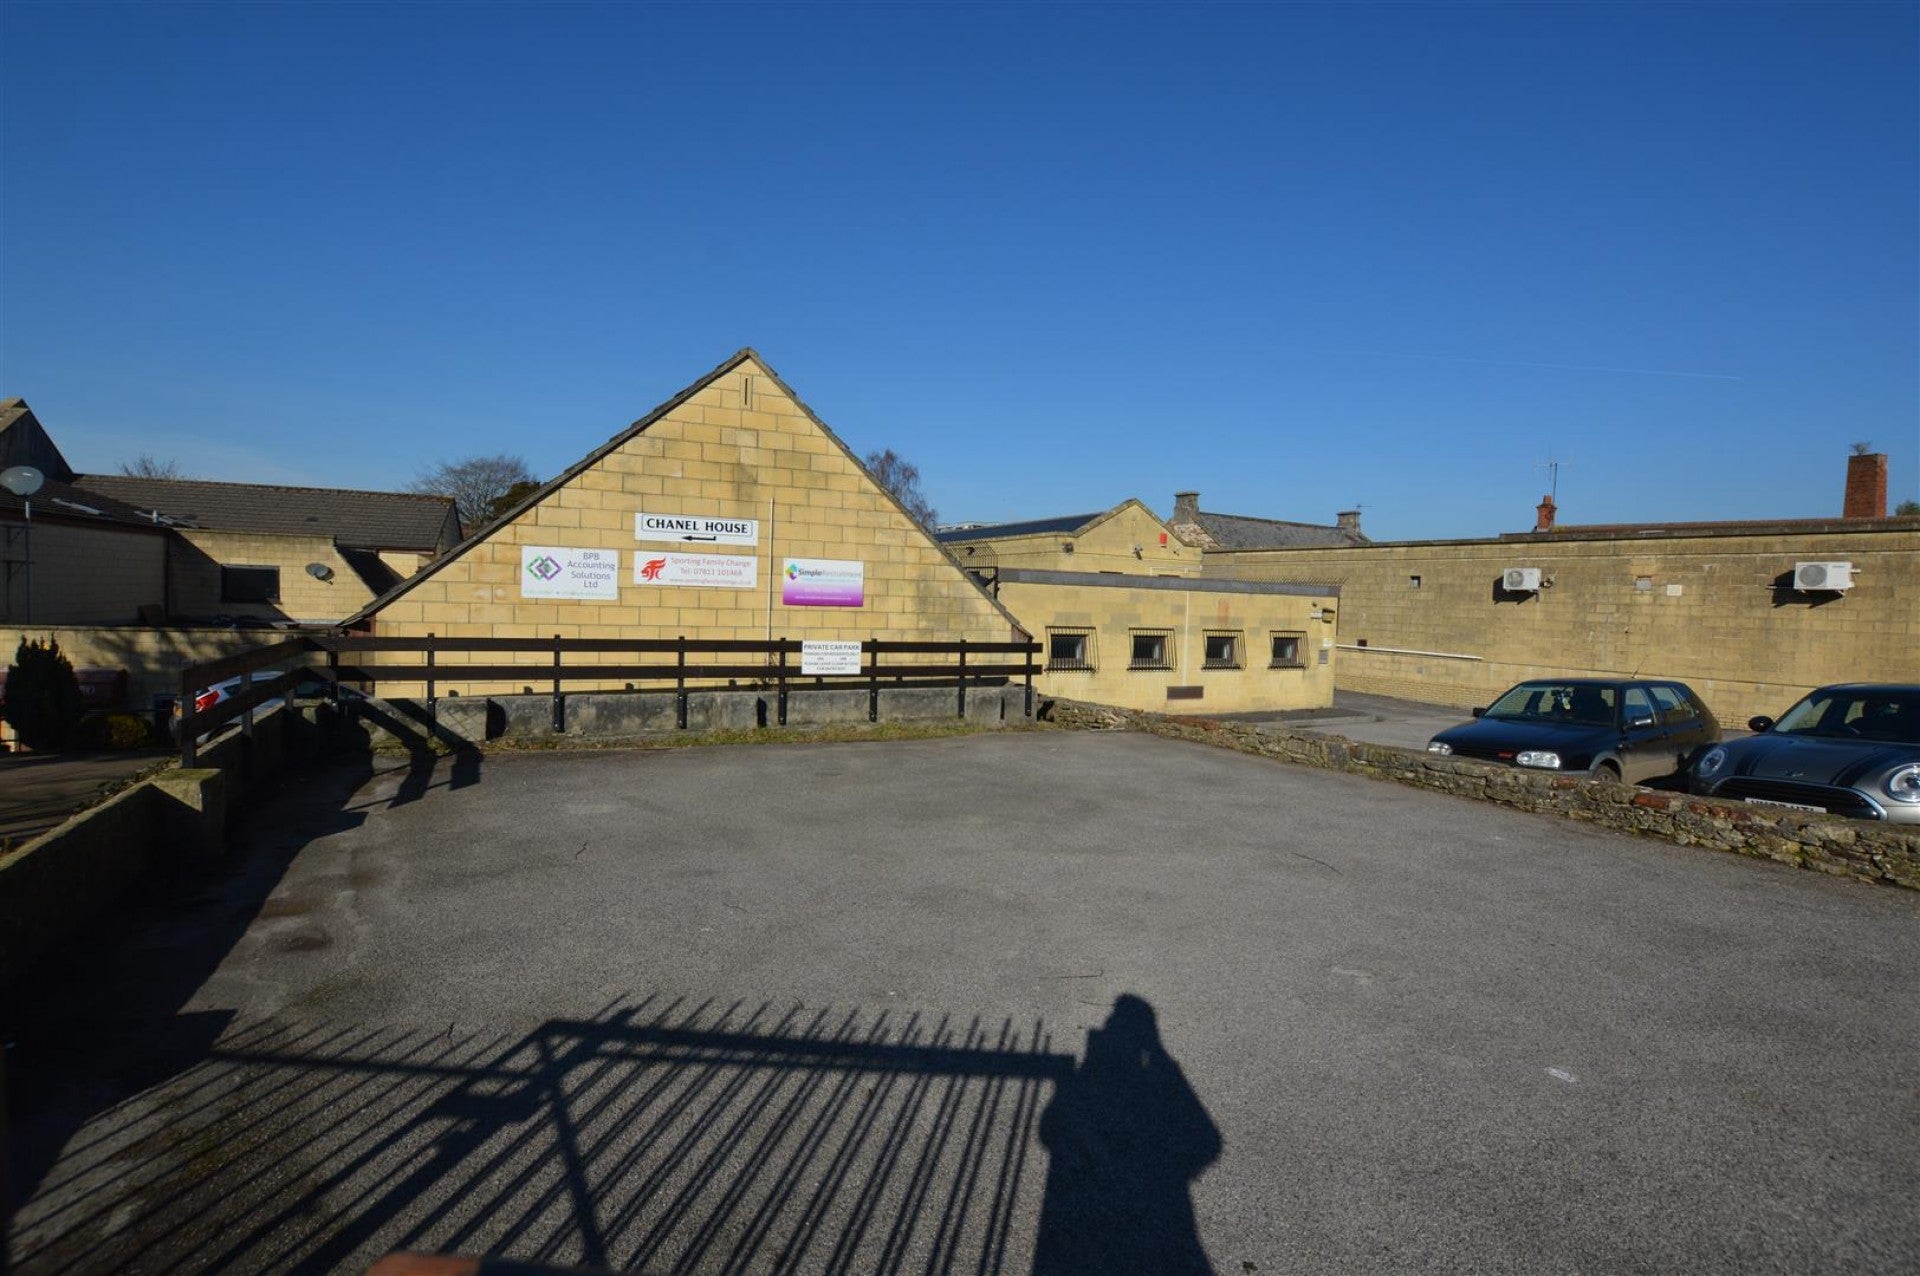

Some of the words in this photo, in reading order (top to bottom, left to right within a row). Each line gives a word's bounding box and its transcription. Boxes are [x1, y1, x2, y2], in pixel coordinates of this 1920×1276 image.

[646, 517, 699, 531] CHANEL
[705, 521, 748, 533] HOUSE
[583, 552, 600, 560] BPB
[567, 560, 616, 571] Accounting
[671, 557, 701, 566] Sporting
[702, 558, 725, 567] Family
[571, 571, 611, 580] Solutions
[583, 580, 598, 588] Ltd
